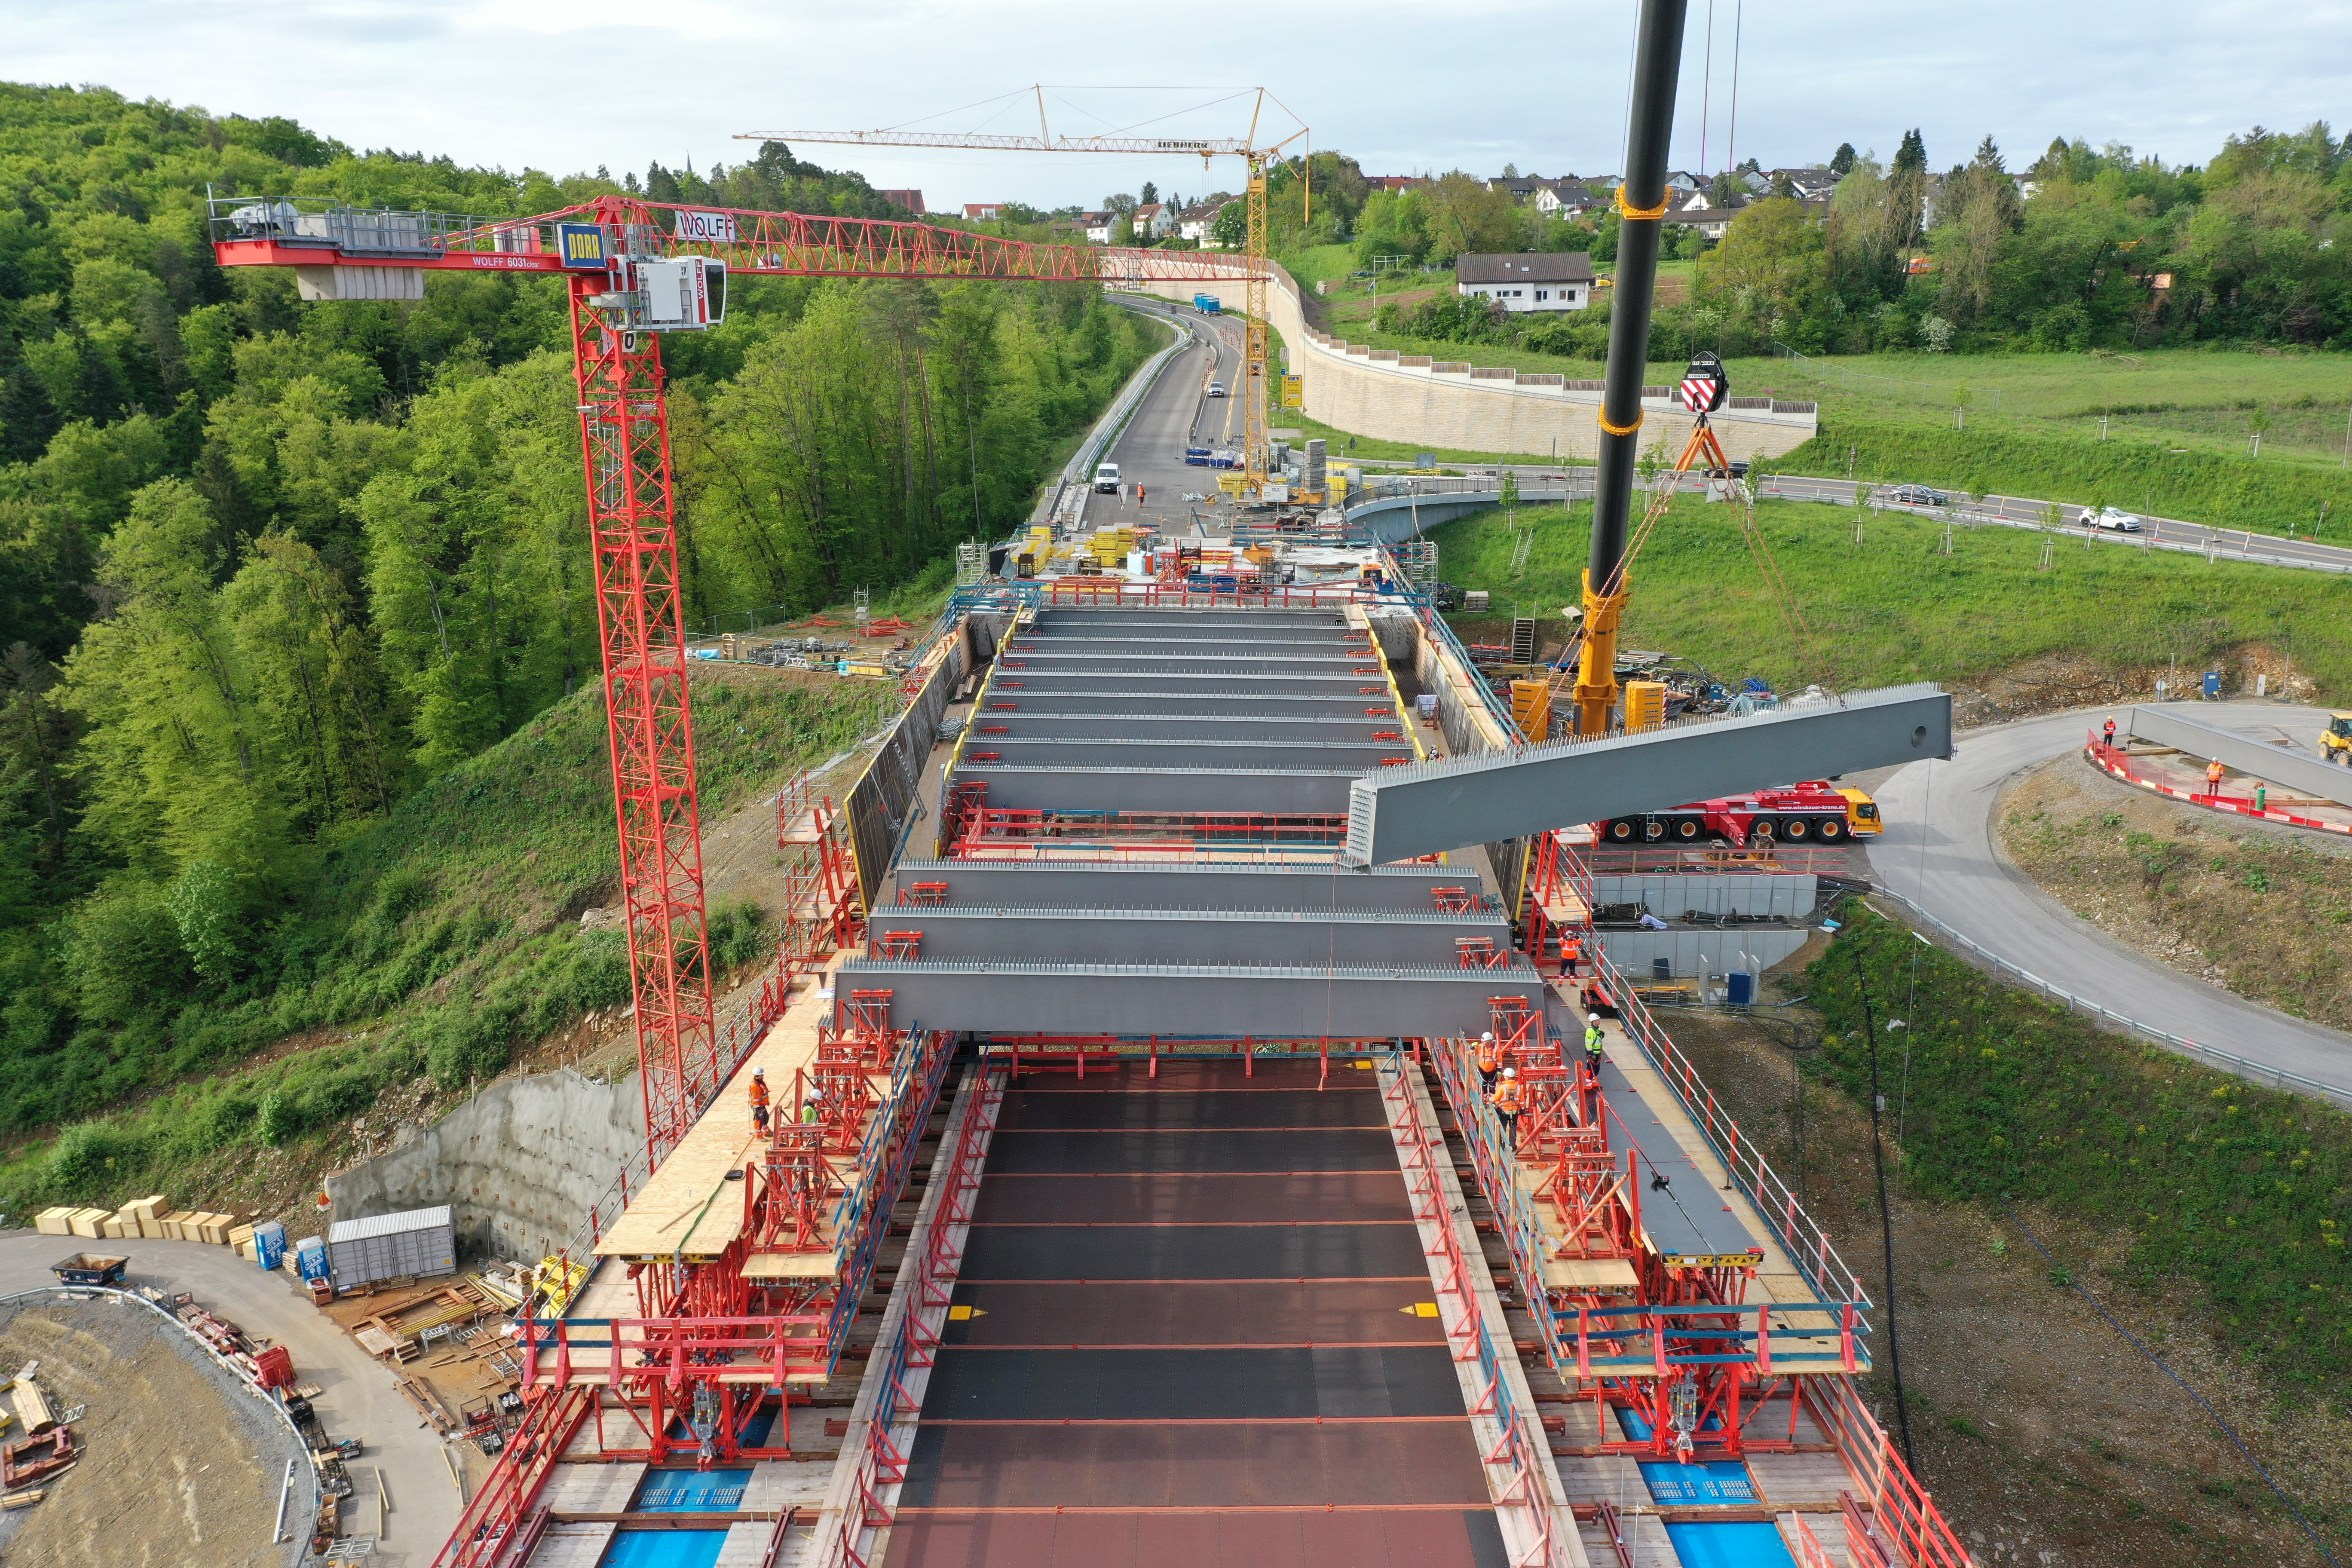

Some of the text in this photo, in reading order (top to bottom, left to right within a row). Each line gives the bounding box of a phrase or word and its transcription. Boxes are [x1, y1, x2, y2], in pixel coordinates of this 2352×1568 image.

[680, 215, 732, 237] WOLFF
[568, 233, 600, 261] PORR
[473, 257, 503, 266] WOLFF
[507, 257, 527, 267] 6031
